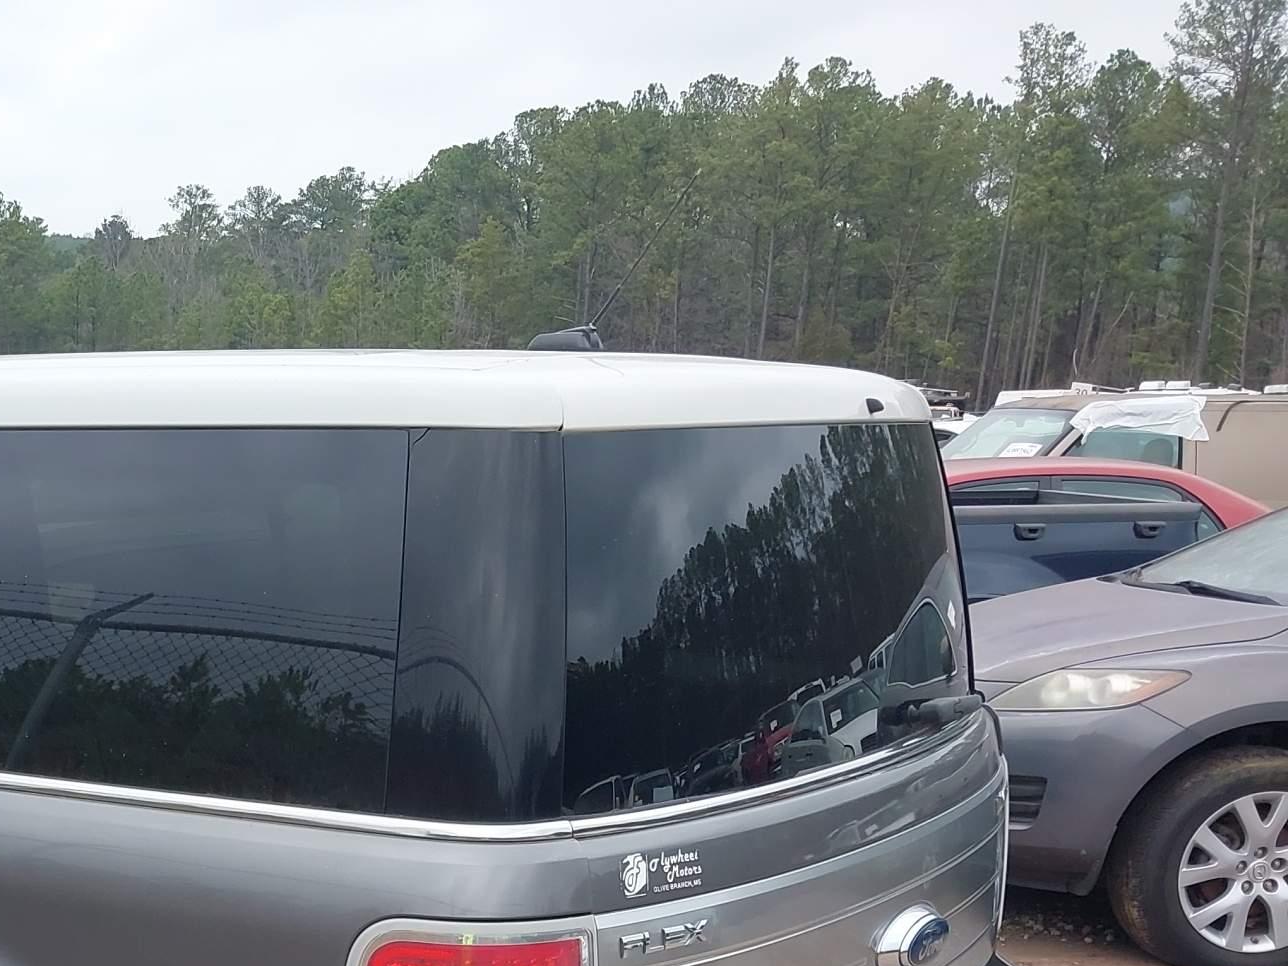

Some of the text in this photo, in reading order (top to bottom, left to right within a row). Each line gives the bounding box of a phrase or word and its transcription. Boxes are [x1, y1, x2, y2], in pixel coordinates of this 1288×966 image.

[667, 864, 702, 883] Motors
[653, 883, 670, 893] OLIVE
[619, 919, 708, 959] FLEX
